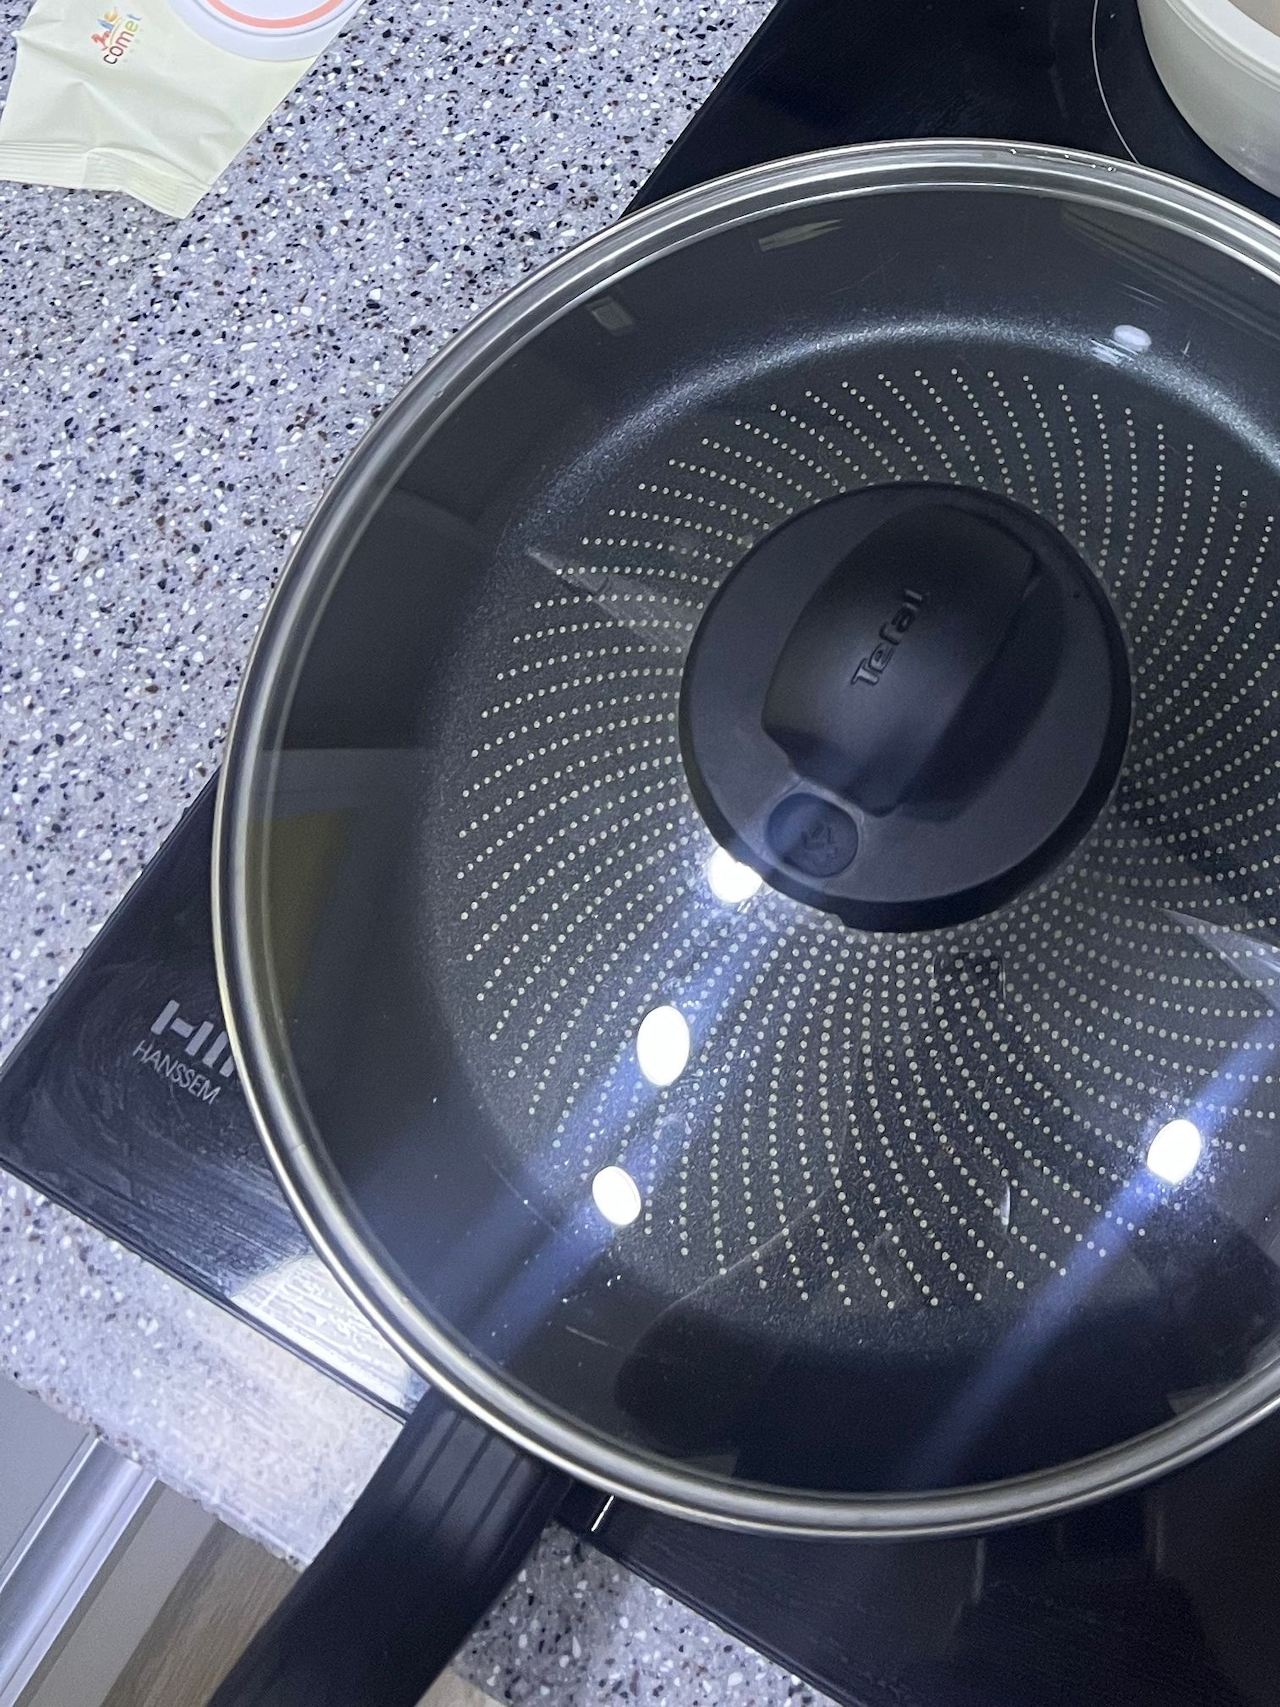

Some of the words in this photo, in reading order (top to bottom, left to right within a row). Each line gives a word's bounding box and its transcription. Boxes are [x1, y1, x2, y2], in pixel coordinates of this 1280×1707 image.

[103, 14, 141, 64] comet
[851, 589, 923, 686] Tefal
[132, 1039, 221, 1105] HANSSEM
